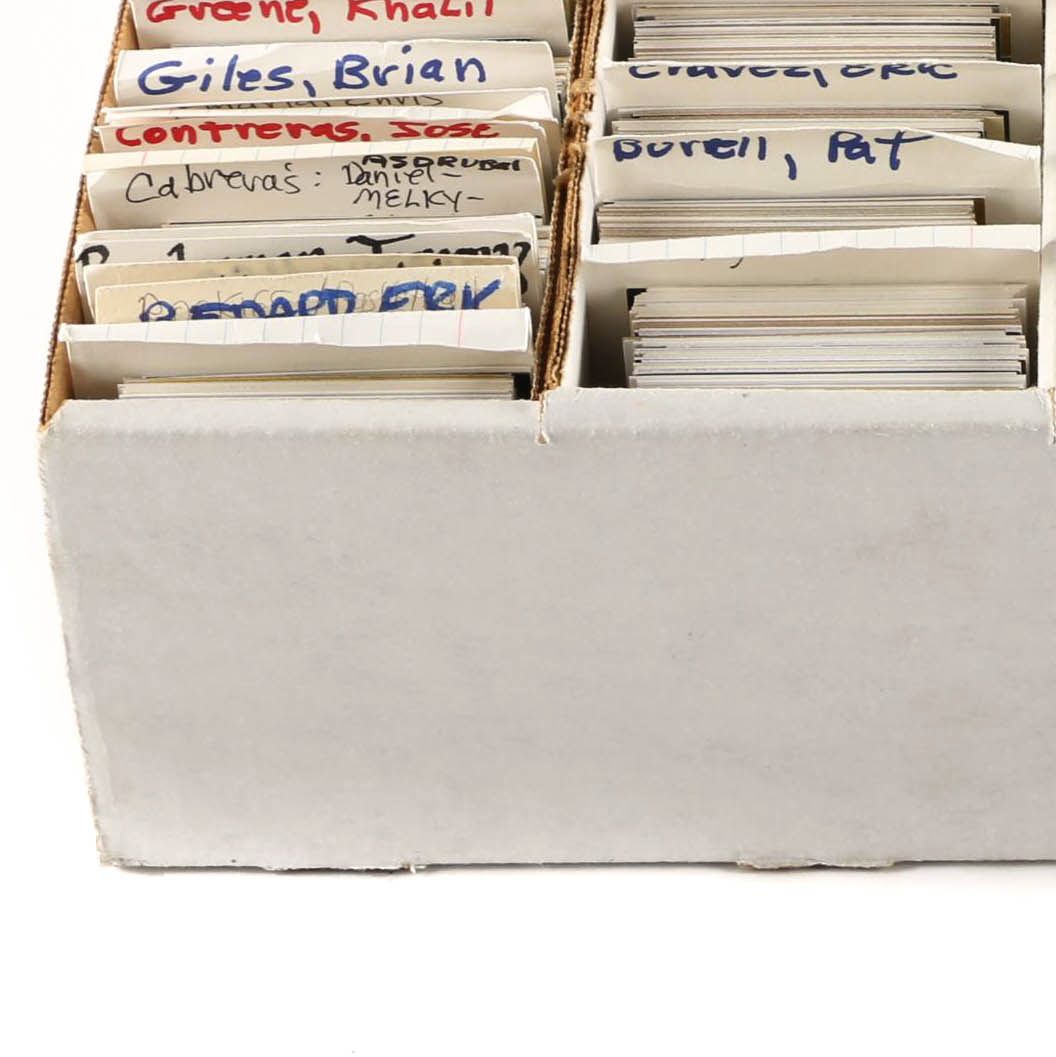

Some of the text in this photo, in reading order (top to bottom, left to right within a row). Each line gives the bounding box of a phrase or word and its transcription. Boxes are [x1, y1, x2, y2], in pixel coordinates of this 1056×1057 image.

[136, 44, 487, 98] Giles, Brian
[827, 130, 935, 171] Pat
